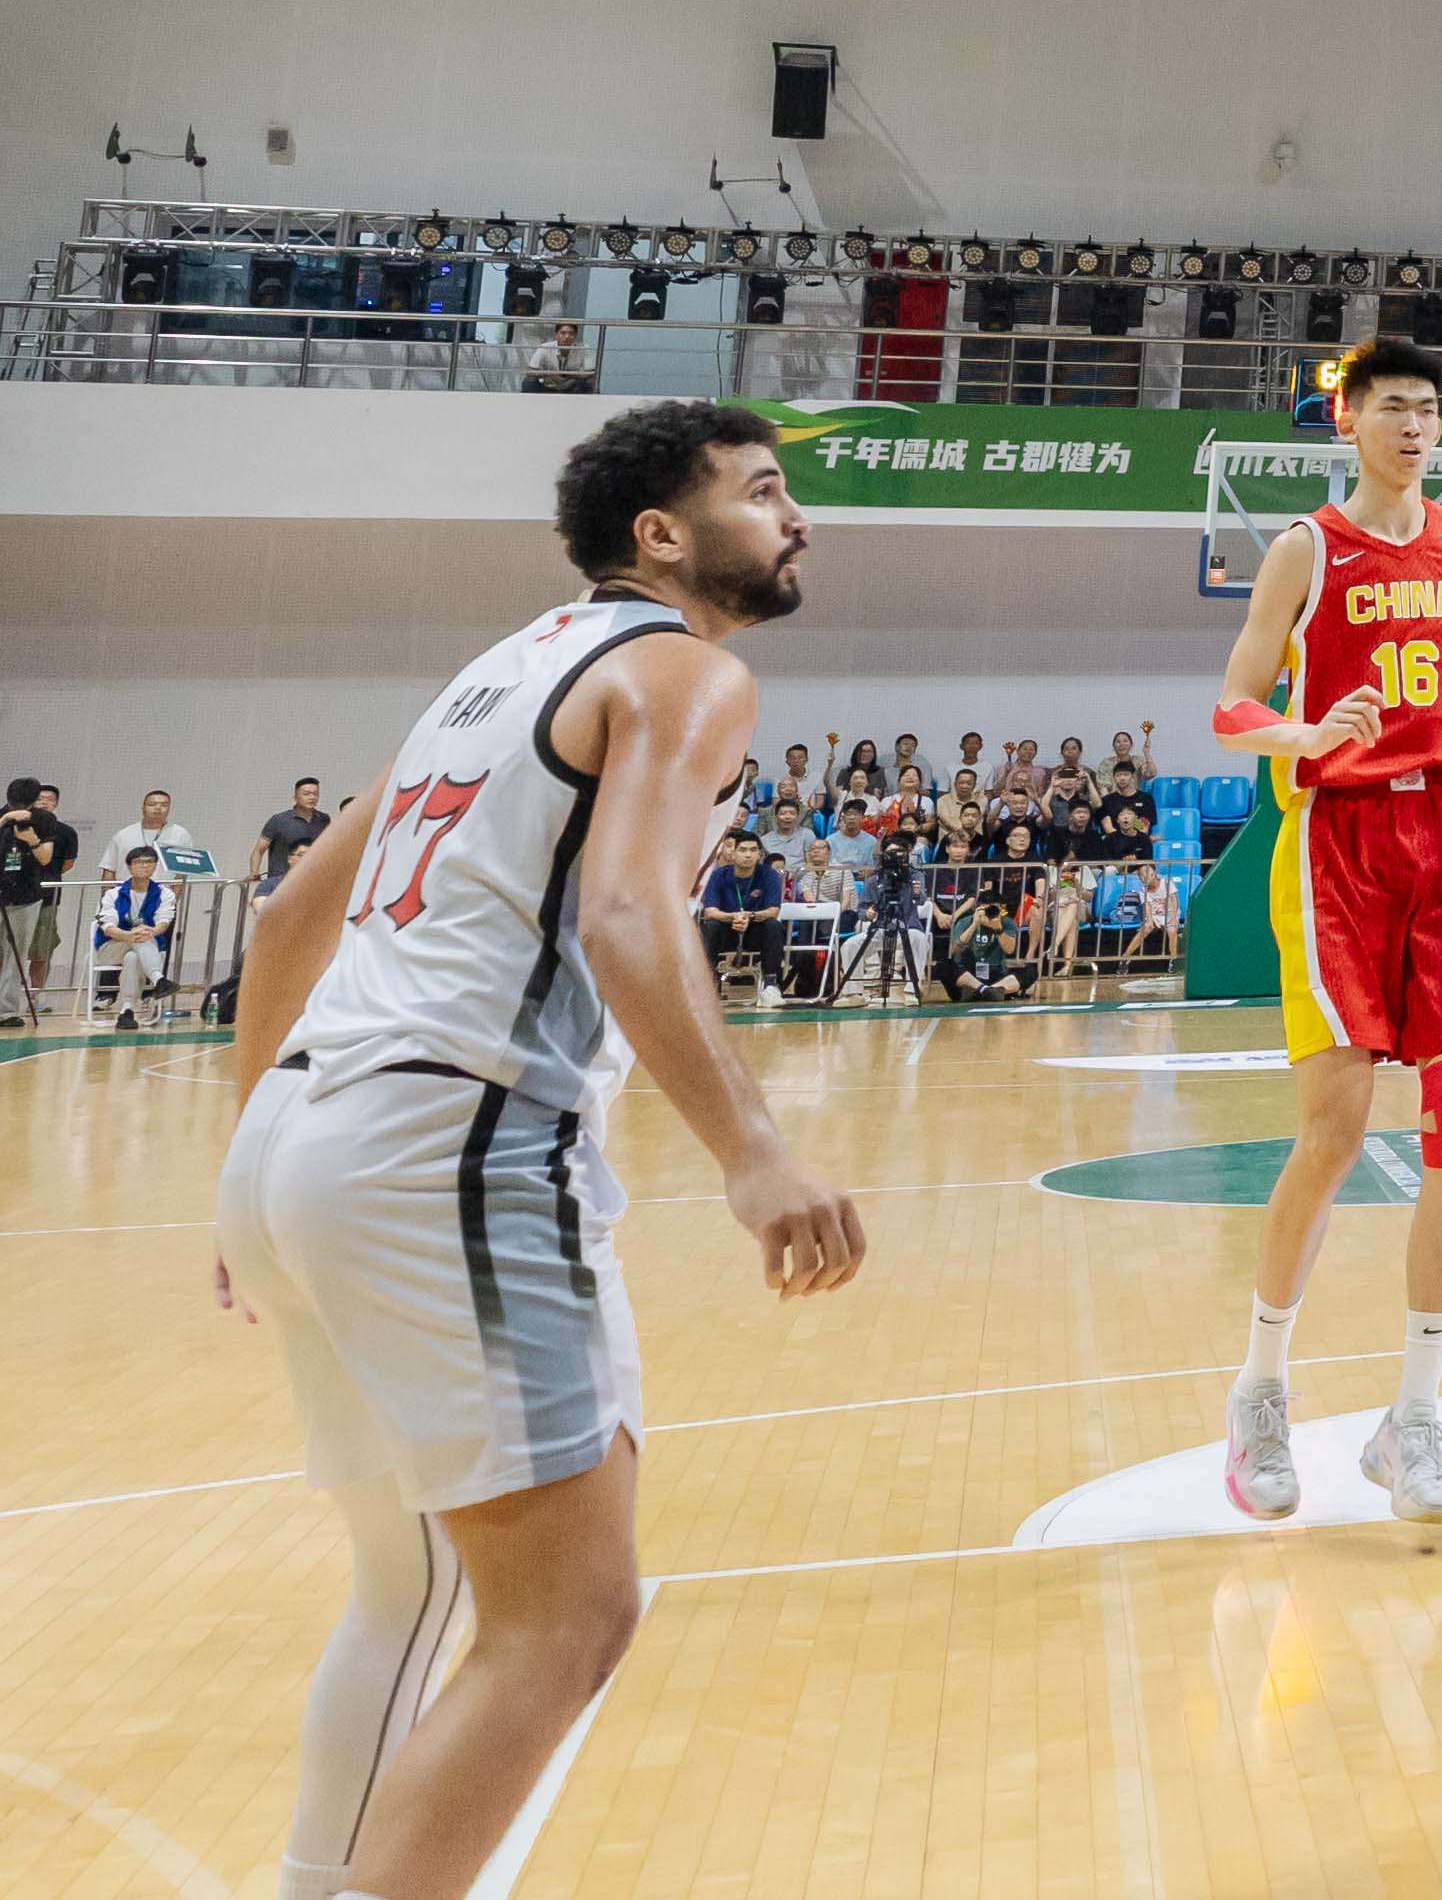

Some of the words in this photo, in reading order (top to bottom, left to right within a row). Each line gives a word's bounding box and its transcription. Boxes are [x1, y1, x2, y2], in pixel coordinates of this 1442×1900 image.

[981, 439, 1134, 475] 古郡犍为
[1370, 640, 1440, 709] 16
